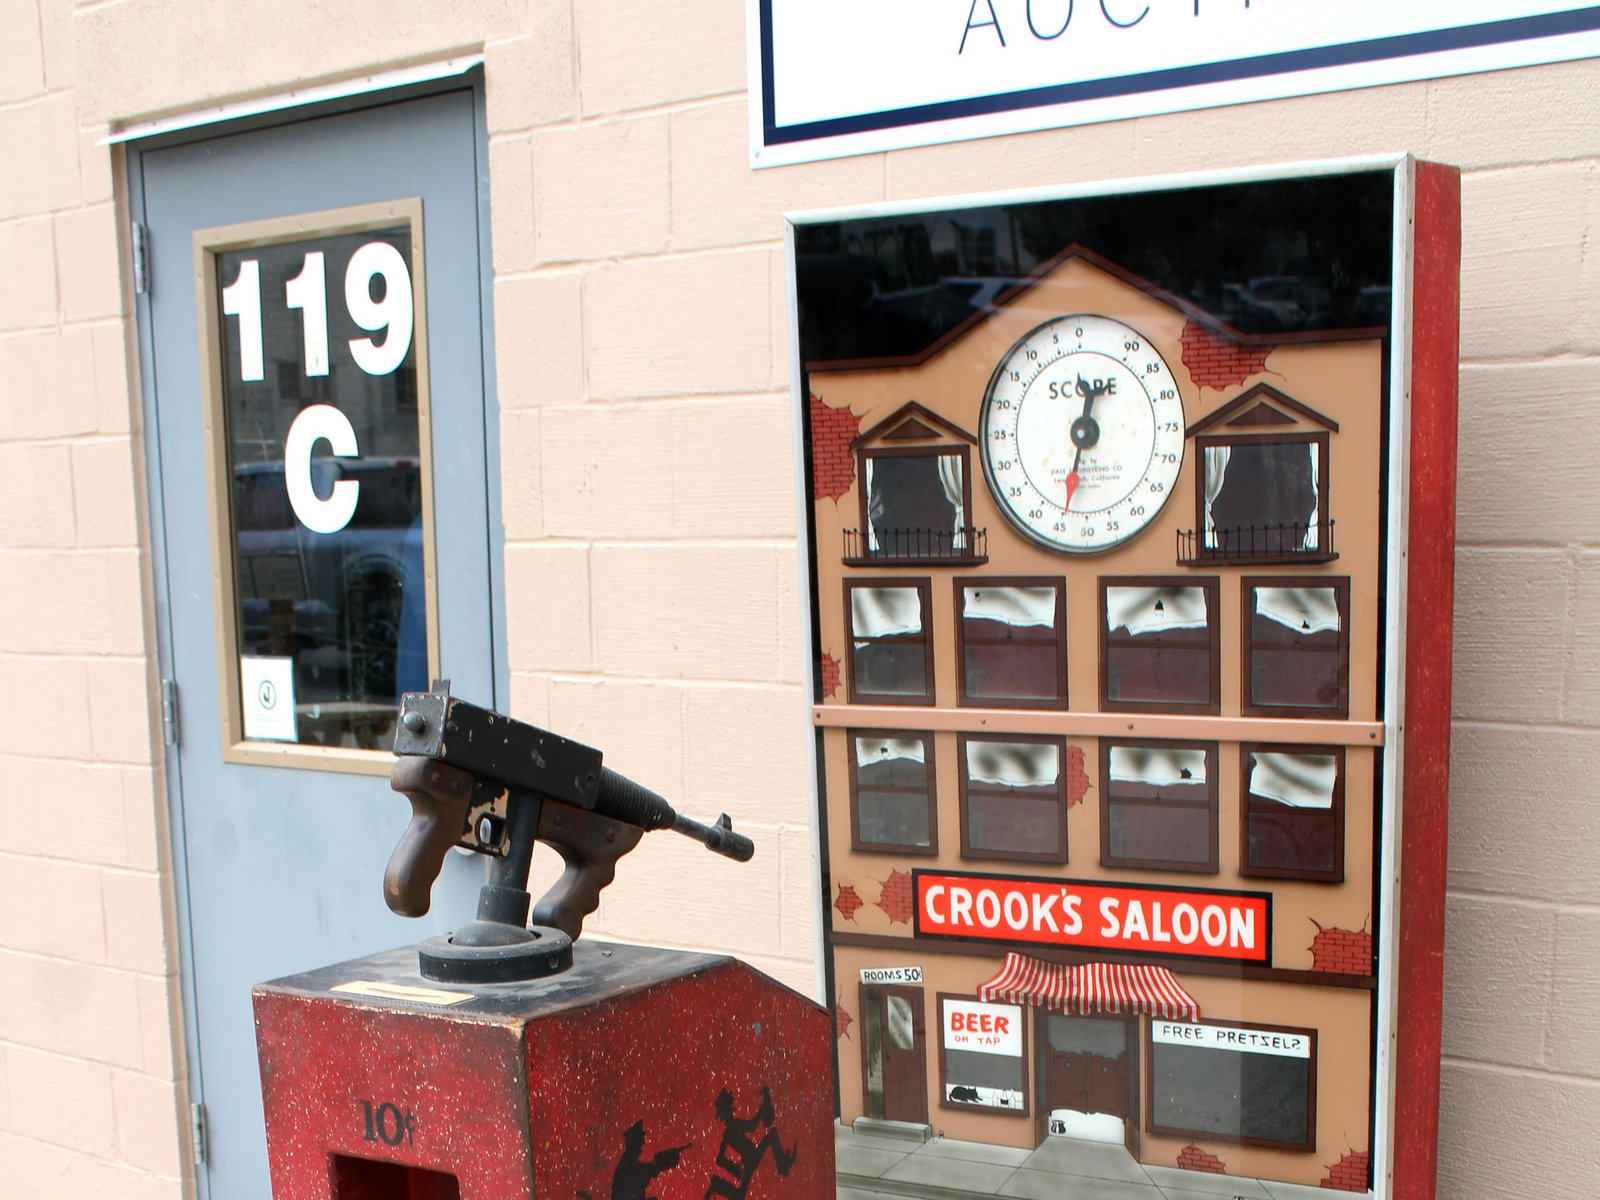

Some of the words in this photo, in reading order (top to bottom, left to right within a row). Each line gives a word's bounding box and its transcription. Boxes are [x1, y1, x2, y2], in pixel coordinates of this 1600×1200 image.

[222, 241, 414, 381] 119
[1053, 333, 1059, 344] 5
[1124, 341, 1140, 352] 90
[1026, 350, 1038, 360] 10
[1146, 363, 1160, 374] 85
[1010, 371, 1020, 382] 15
[1160, 389, 1175, 400] 80
[997, 400, 1010, 410] 20
[1165, 422, 1179, 433] 75
[994, 430, 1006, 440] 25
[1161, 453, 1176, 464] 70
[284, 404, 359, 534] C
[998, 461, 1012, 471] 30
[1010, 487, 1022, 497] 35
[1150, 482, 1163, 492] 65
[1029, 509, 1043, 519] 40
[1130, 505, 1145, 516] 60
[1053, 522, 1066, 532] 45
[1107, 520, 1119, 531] 55
[1080, 527, 1095, 537] 50
[924, 885, 1083, 935] CROOK'S
[1099, 896, 1255, 949] SALOON
[864, 970, 902, 980] ROOMS
[951, 1012, 1009, 1035] BEER
[1163, 1025, 1203, 1040] FREE
[977, 1036, 1000, 1045] TAP
